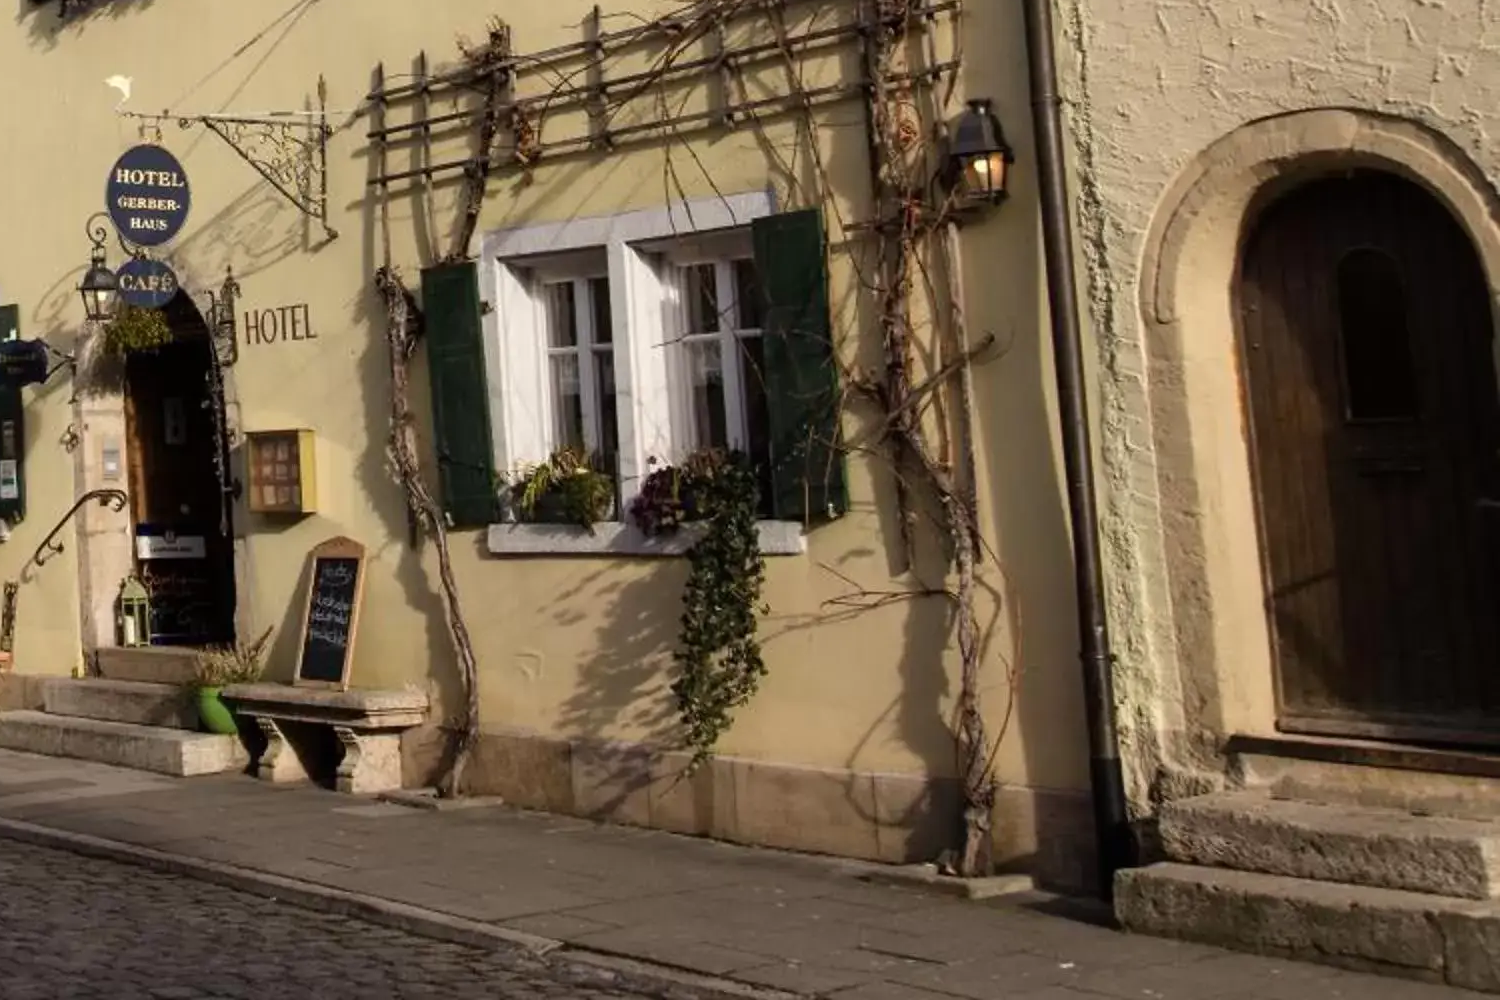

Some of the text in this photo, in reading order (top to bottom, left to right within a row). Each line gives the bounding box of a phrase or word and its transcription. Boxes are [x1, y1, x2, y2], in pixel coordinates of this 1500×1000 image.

[115, 168, 185, 188] HOTEL
[117, 194, 181, 211] GERBER-
[129, 217, 169, 231] HAUS
[118, 271, 174, 293] CAFÉ
[243, 303, 318, 345] HOTEL
